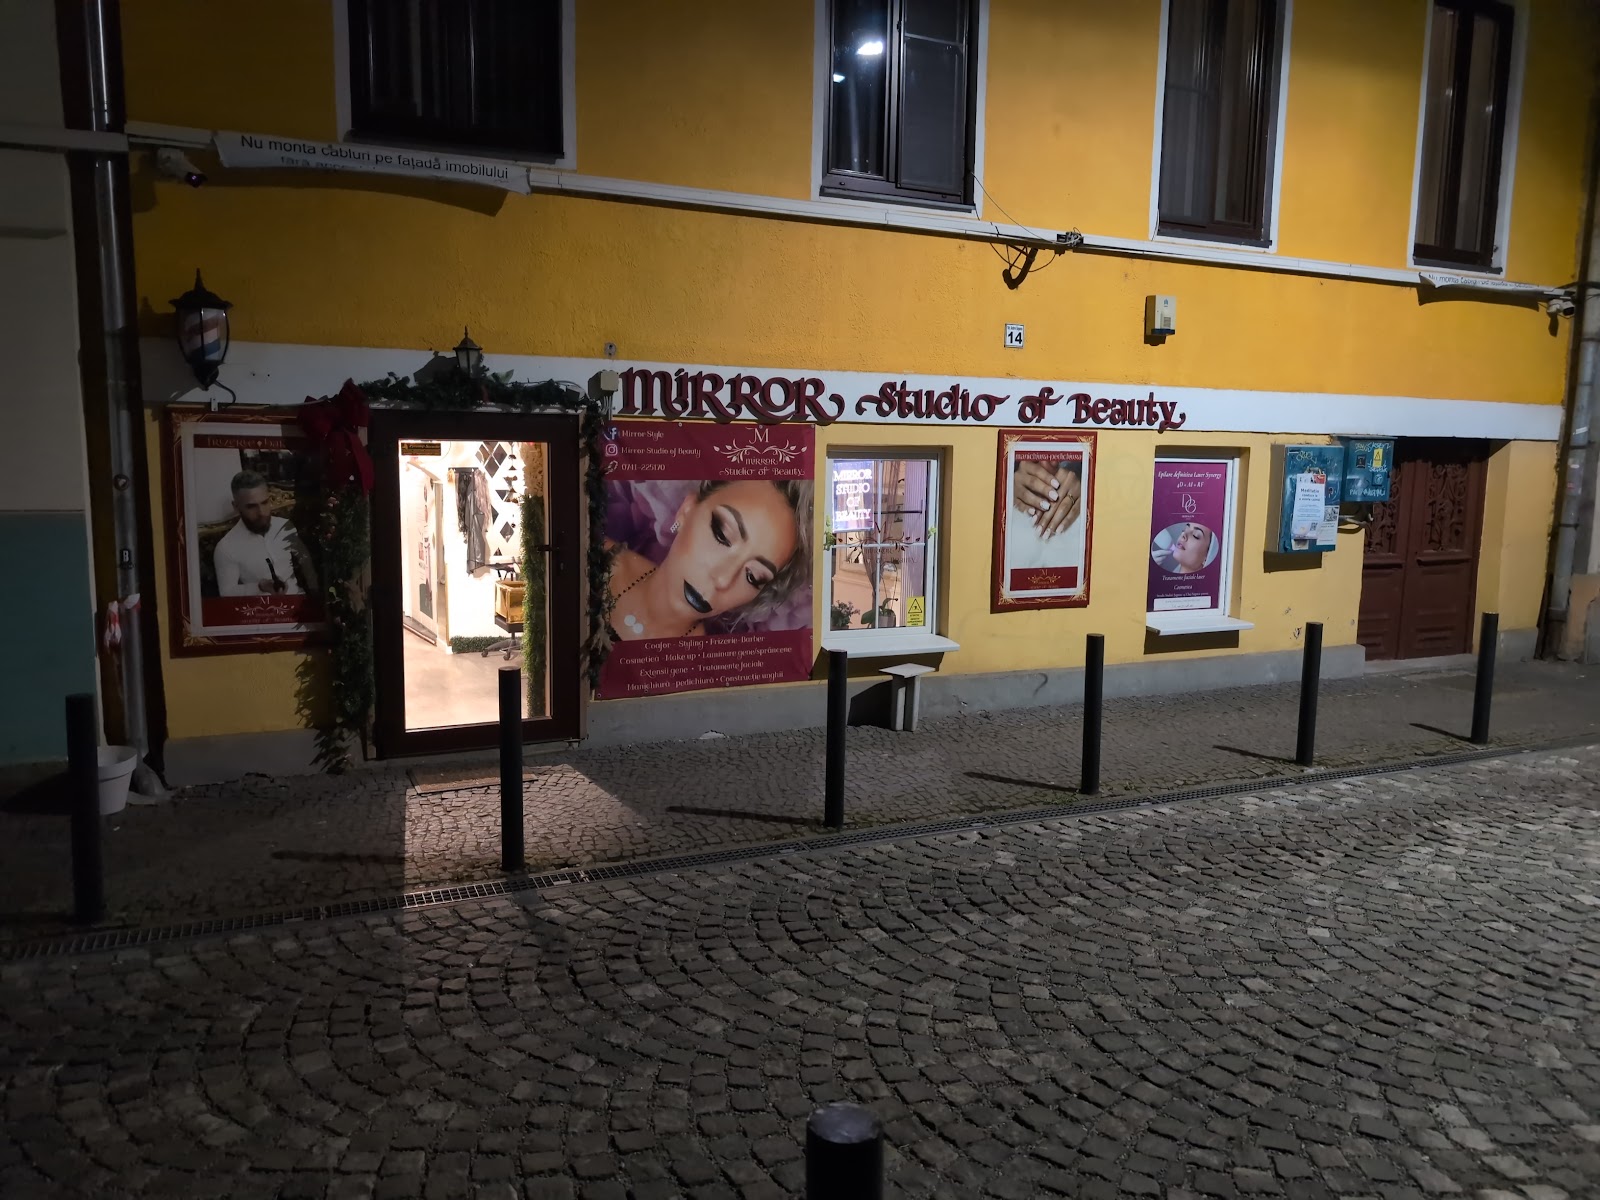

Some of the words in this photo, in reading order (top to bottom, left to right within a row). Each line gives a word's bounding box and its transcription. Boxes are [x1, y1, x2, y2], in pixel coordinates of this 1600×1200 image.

[240, 135, 263, 149] Nu
[268, 140, 316, 155] monta
[321, 147, 370, 161] cabluri
[375, 155, 392, 165] pe
[445, 161, 508, 179] imobilului
[1008, 331, 1022, 344] 14
[855, 381, 1010, 422] Studio
[1017, 387, 1064, 425] of
[1067, 392, 1186, 433] Beauty
[833, 469, 872, 481] MIRROR
[678, 640, 704, 650] Styling
